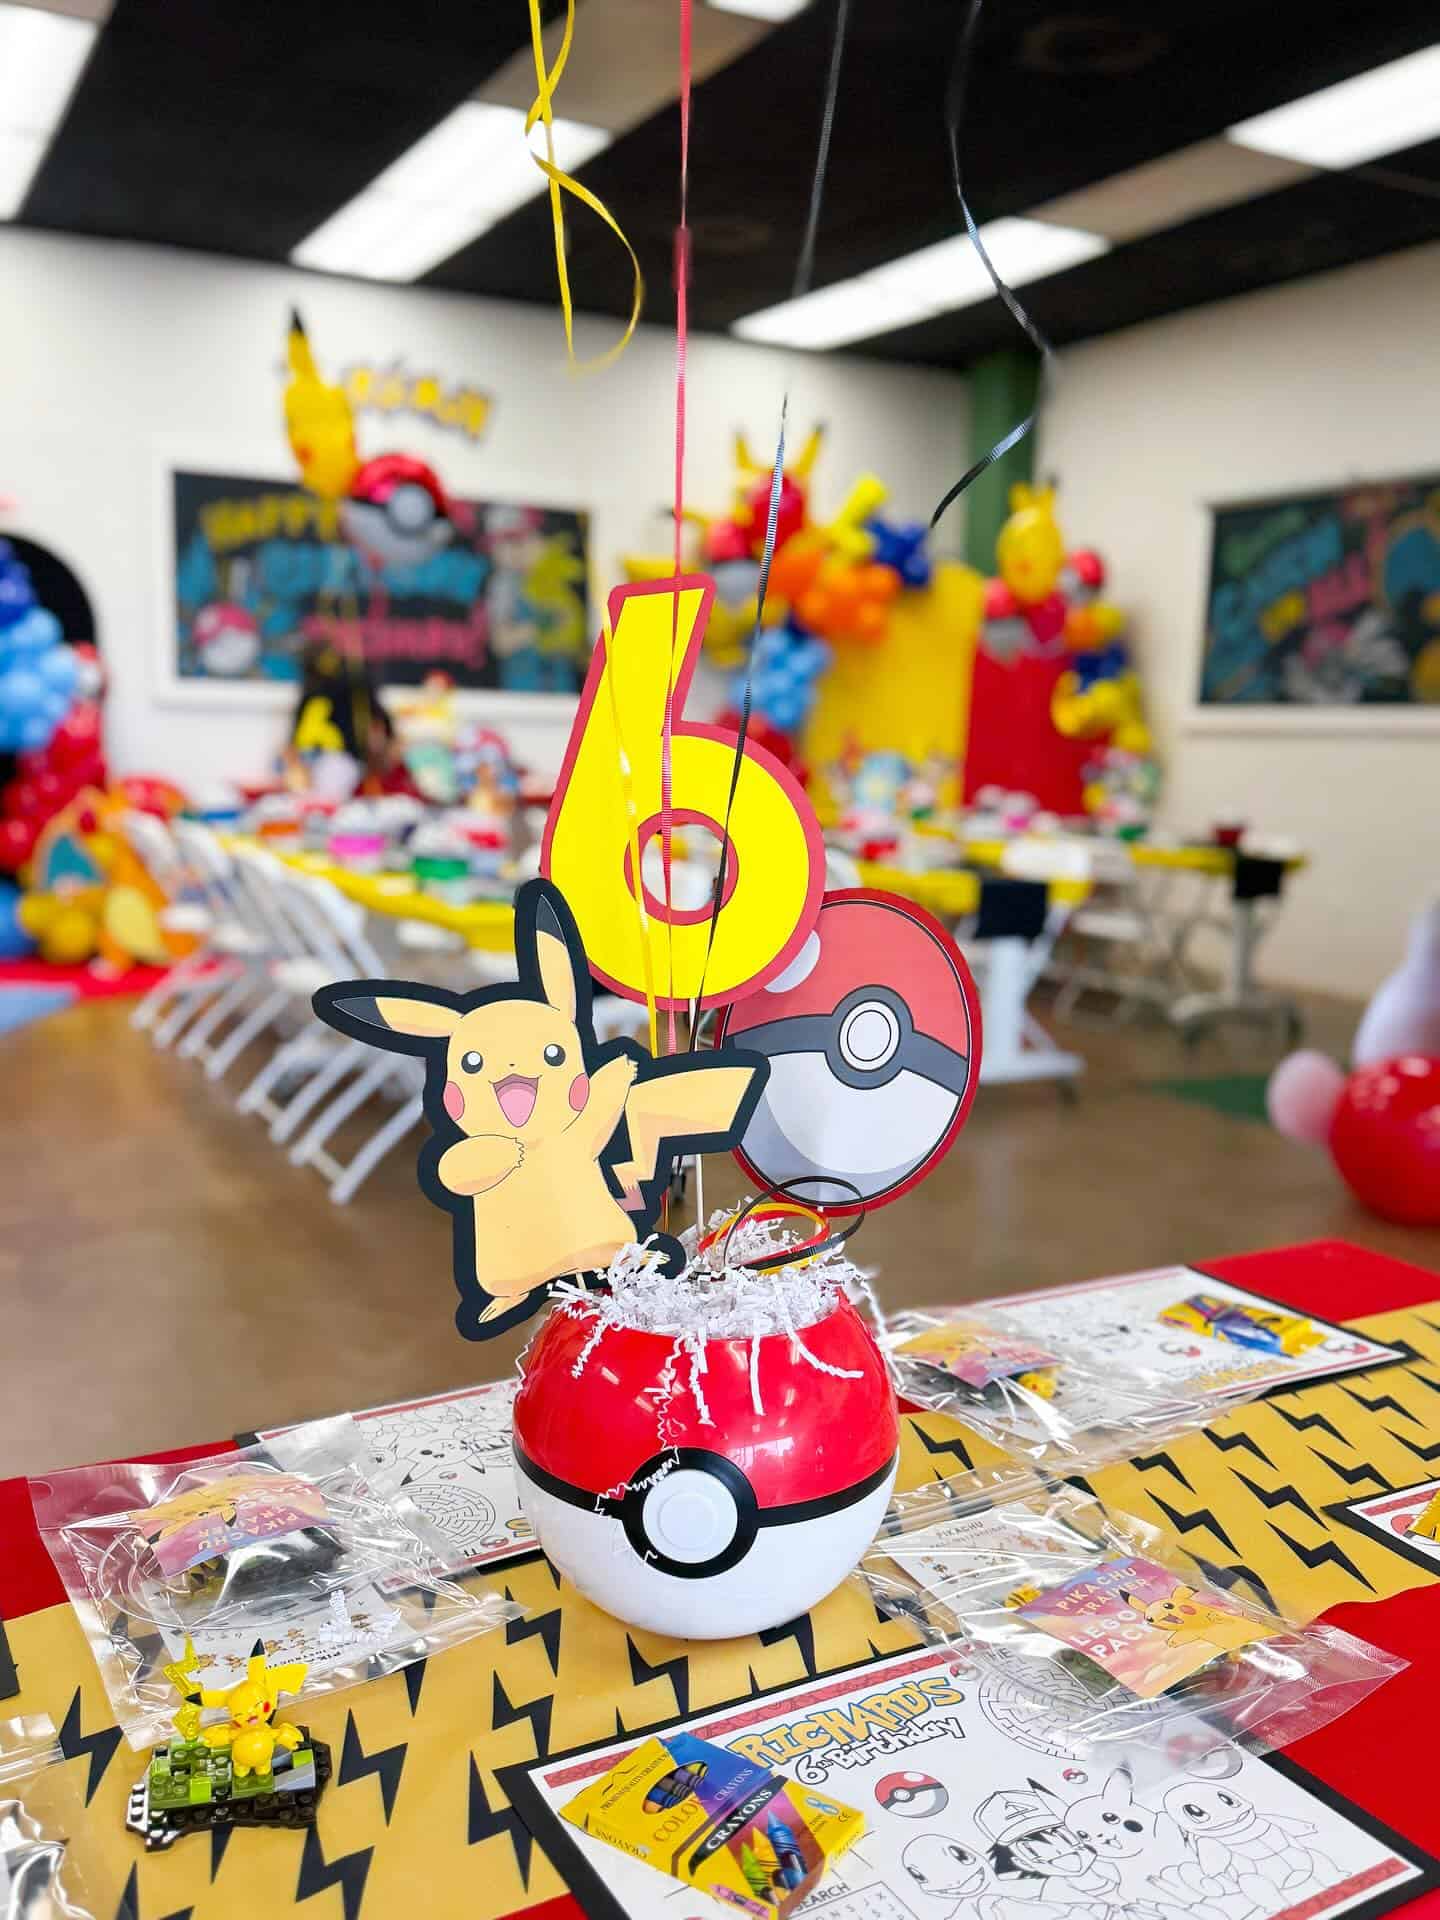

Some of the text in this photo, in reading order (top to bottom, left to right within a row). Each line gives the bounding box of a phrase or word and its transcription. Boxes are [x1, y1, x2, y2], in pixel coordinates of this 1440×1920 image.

[1056, 1567, 1137, 1610] PIKACHU
[1070, 1609, 1138, 1647] LEGO
[725, 1677, 966, 1768] RICHARD'S
[822, 1717, 966, 1770] Birthday
[713, 1767, 753, 1801] CRAYONS
[706, 1789, 773, 1850] CRAYONS
